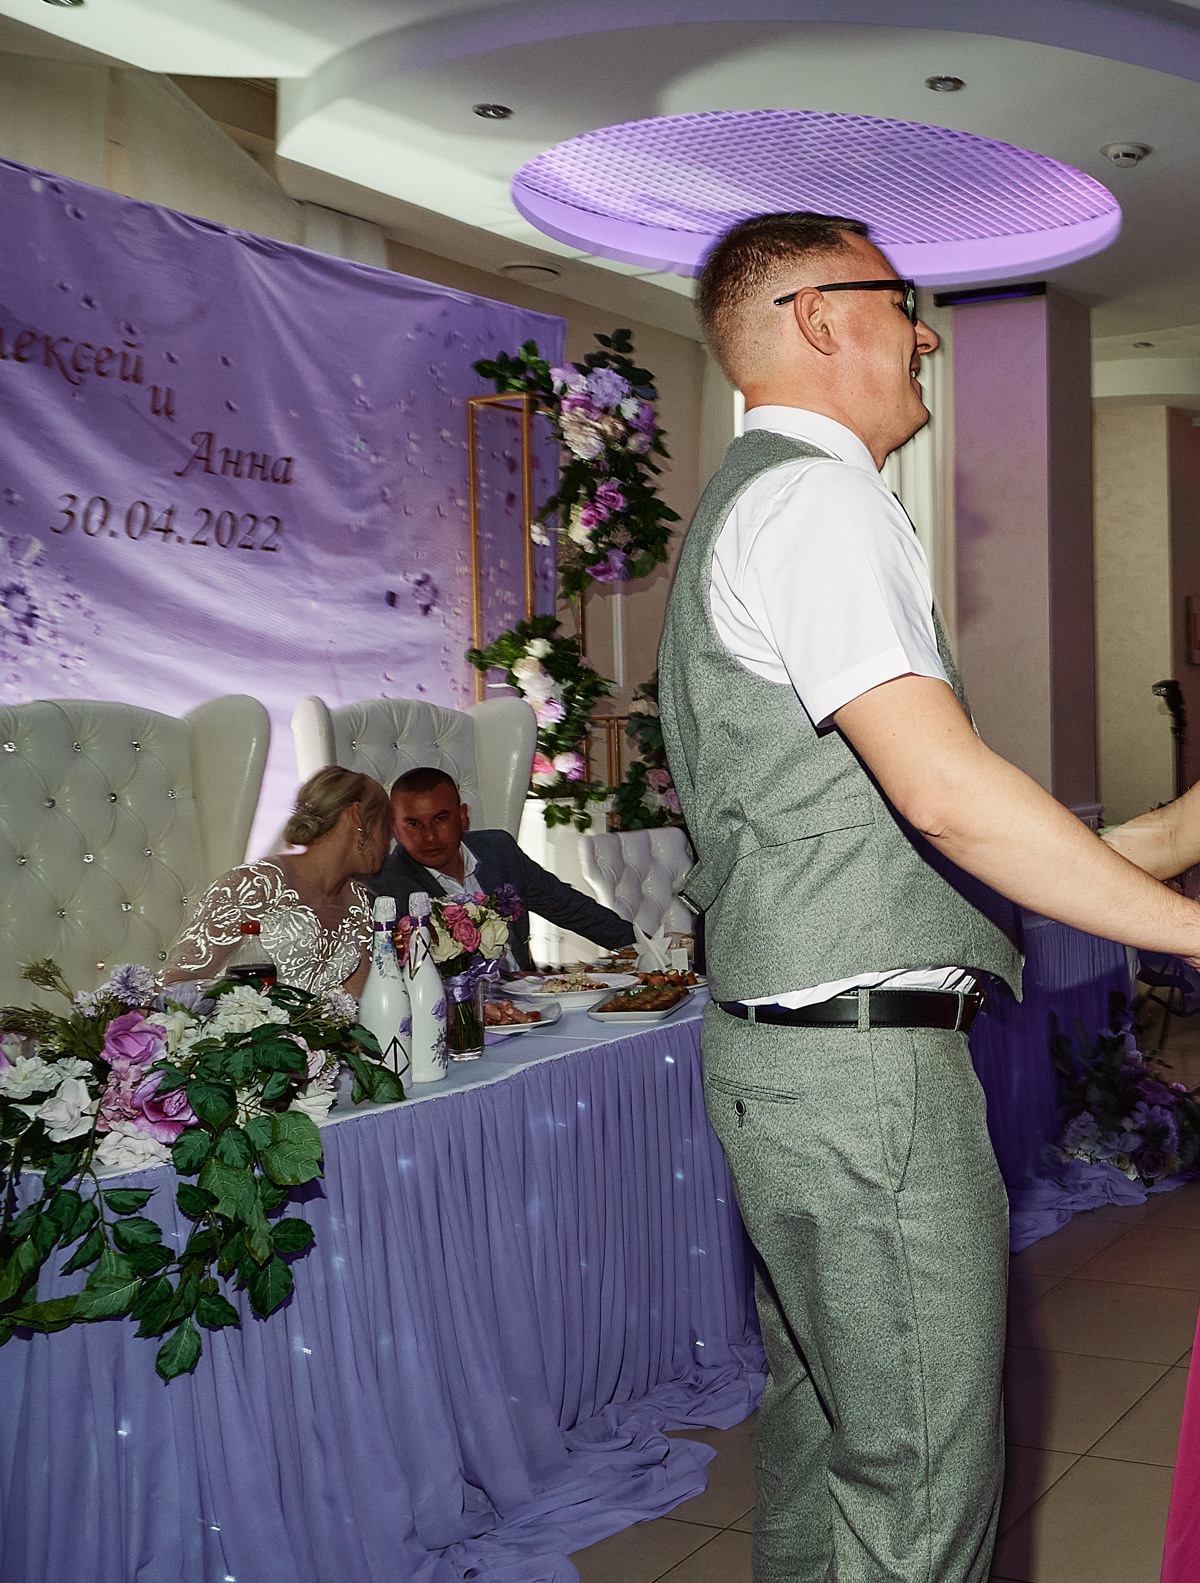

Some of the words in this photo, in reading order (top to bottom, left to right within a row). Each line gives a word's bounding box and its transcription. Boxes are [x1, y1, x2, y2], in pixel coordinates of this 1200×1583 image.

[146, 382, 176, 421] и
[173, 430, 296, 486] Анна
[50, 493, 282, 552] 30.04.2022
